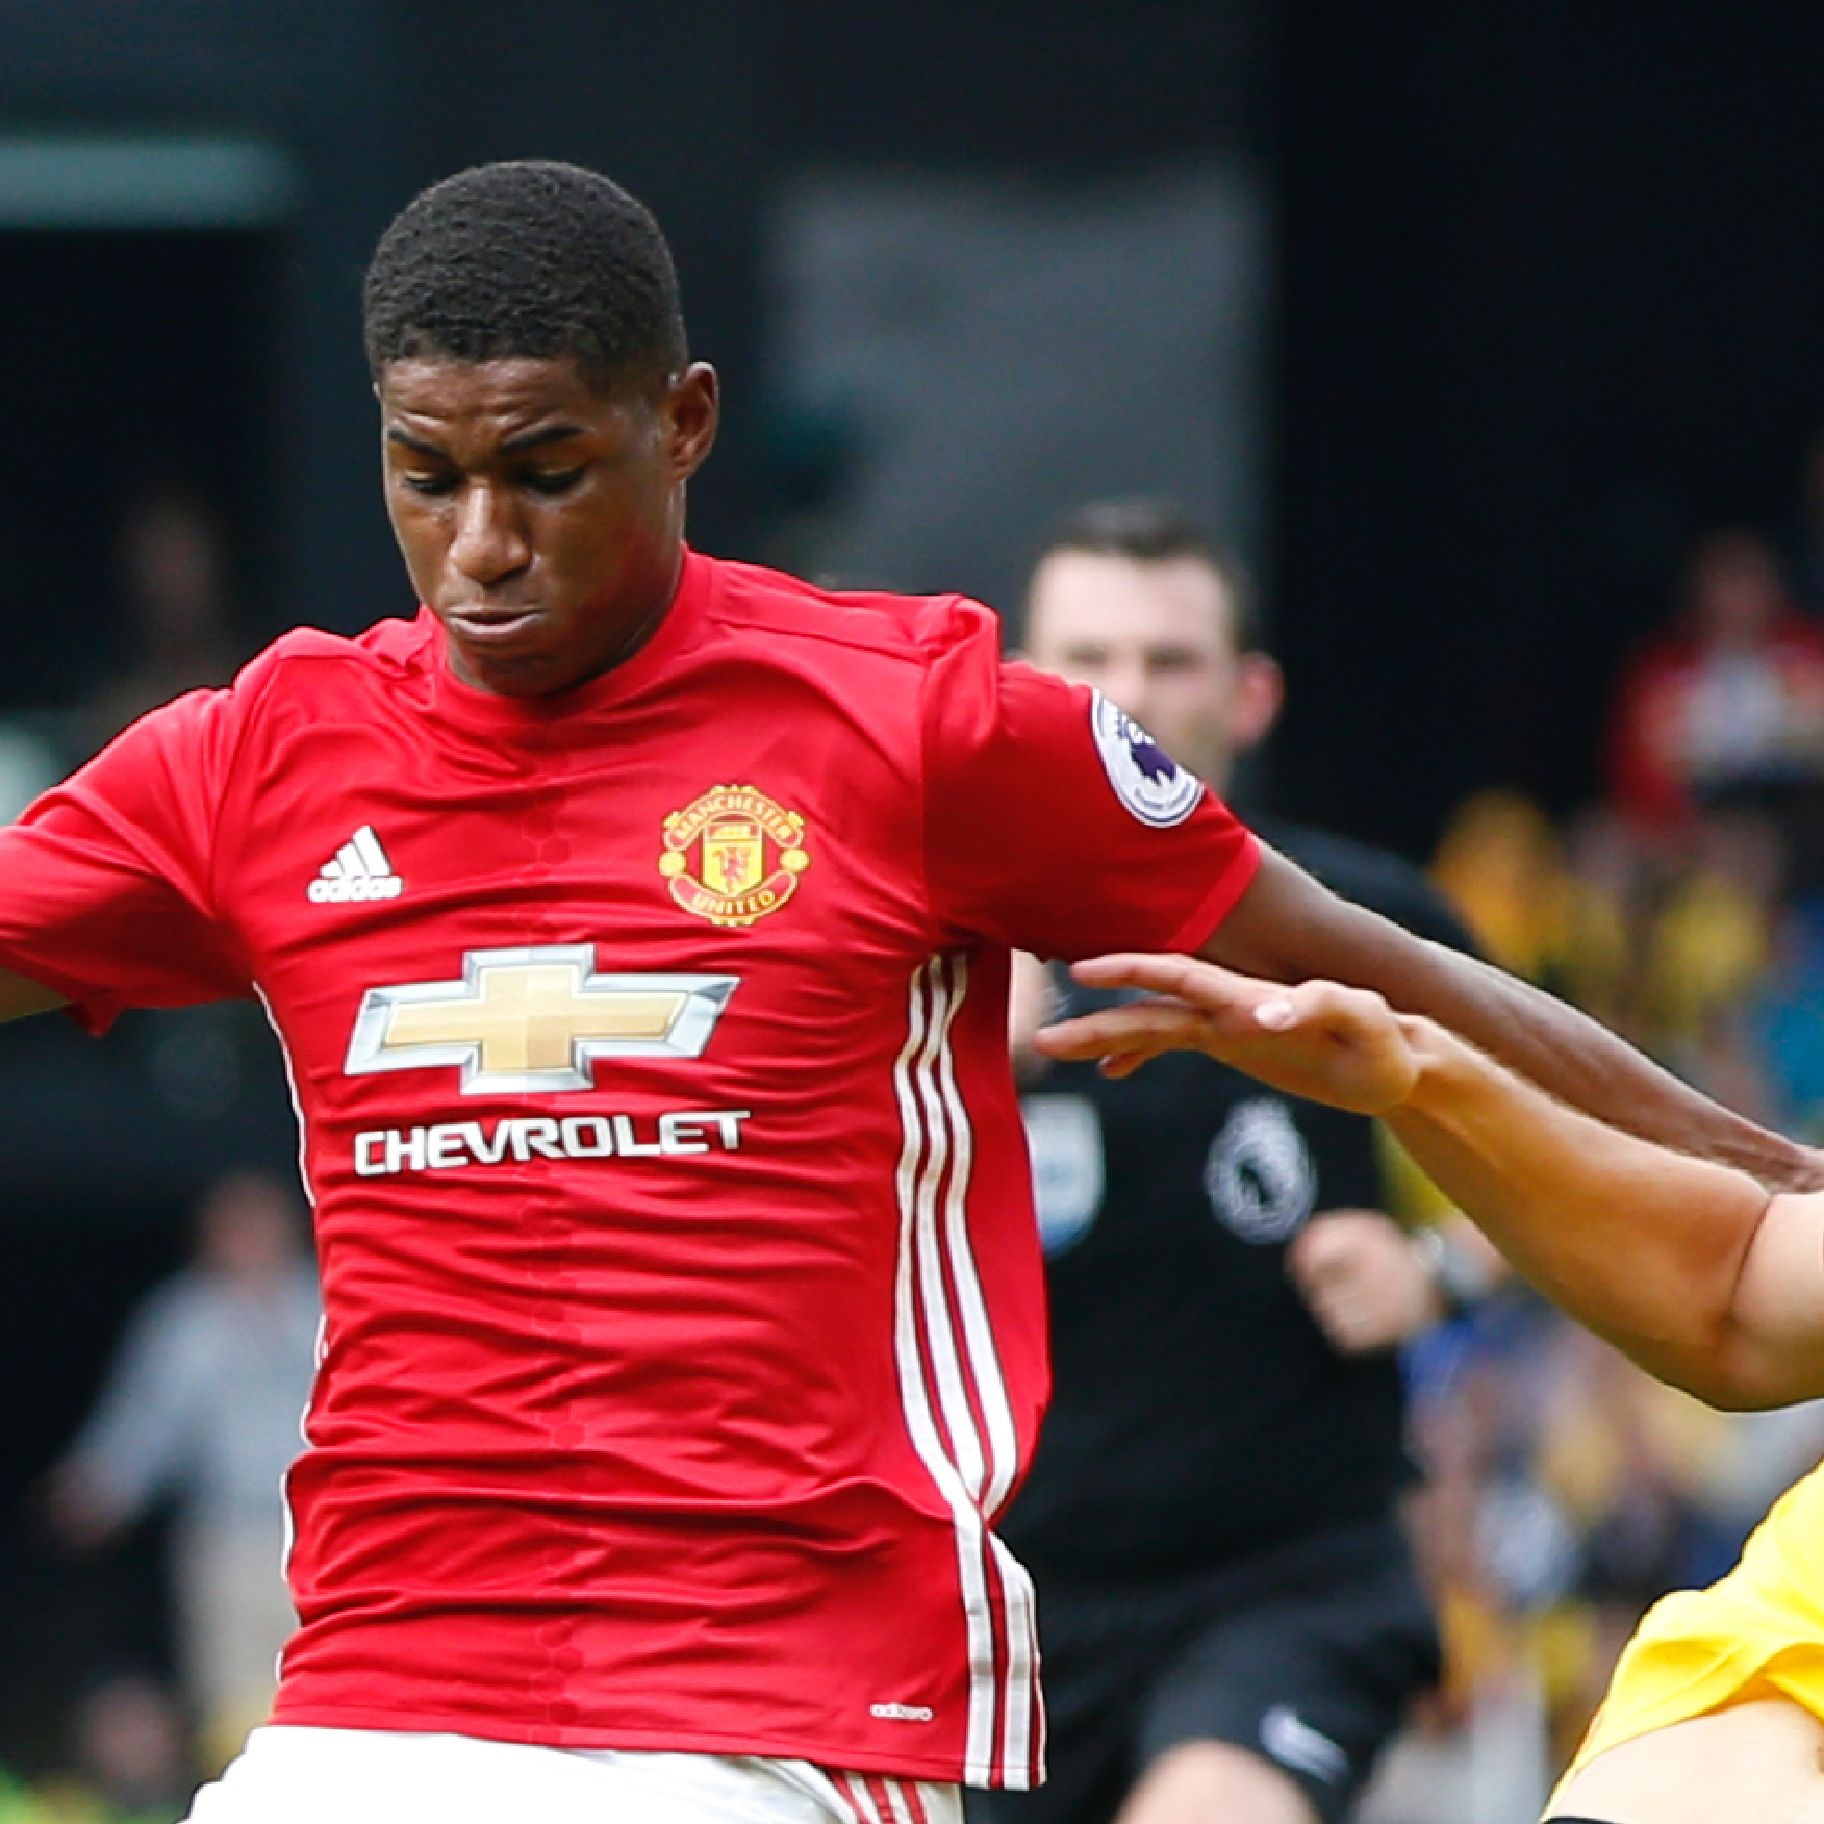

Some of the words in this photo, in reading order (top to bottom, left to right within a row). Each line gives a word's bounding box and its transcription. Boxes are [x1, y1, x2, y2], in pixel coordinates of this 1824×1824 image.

[307, 875, 404, 904] adidas
[691, 888, 776, 915] UNITED
[354, 1110, 752, 1177] CHEVROLET
